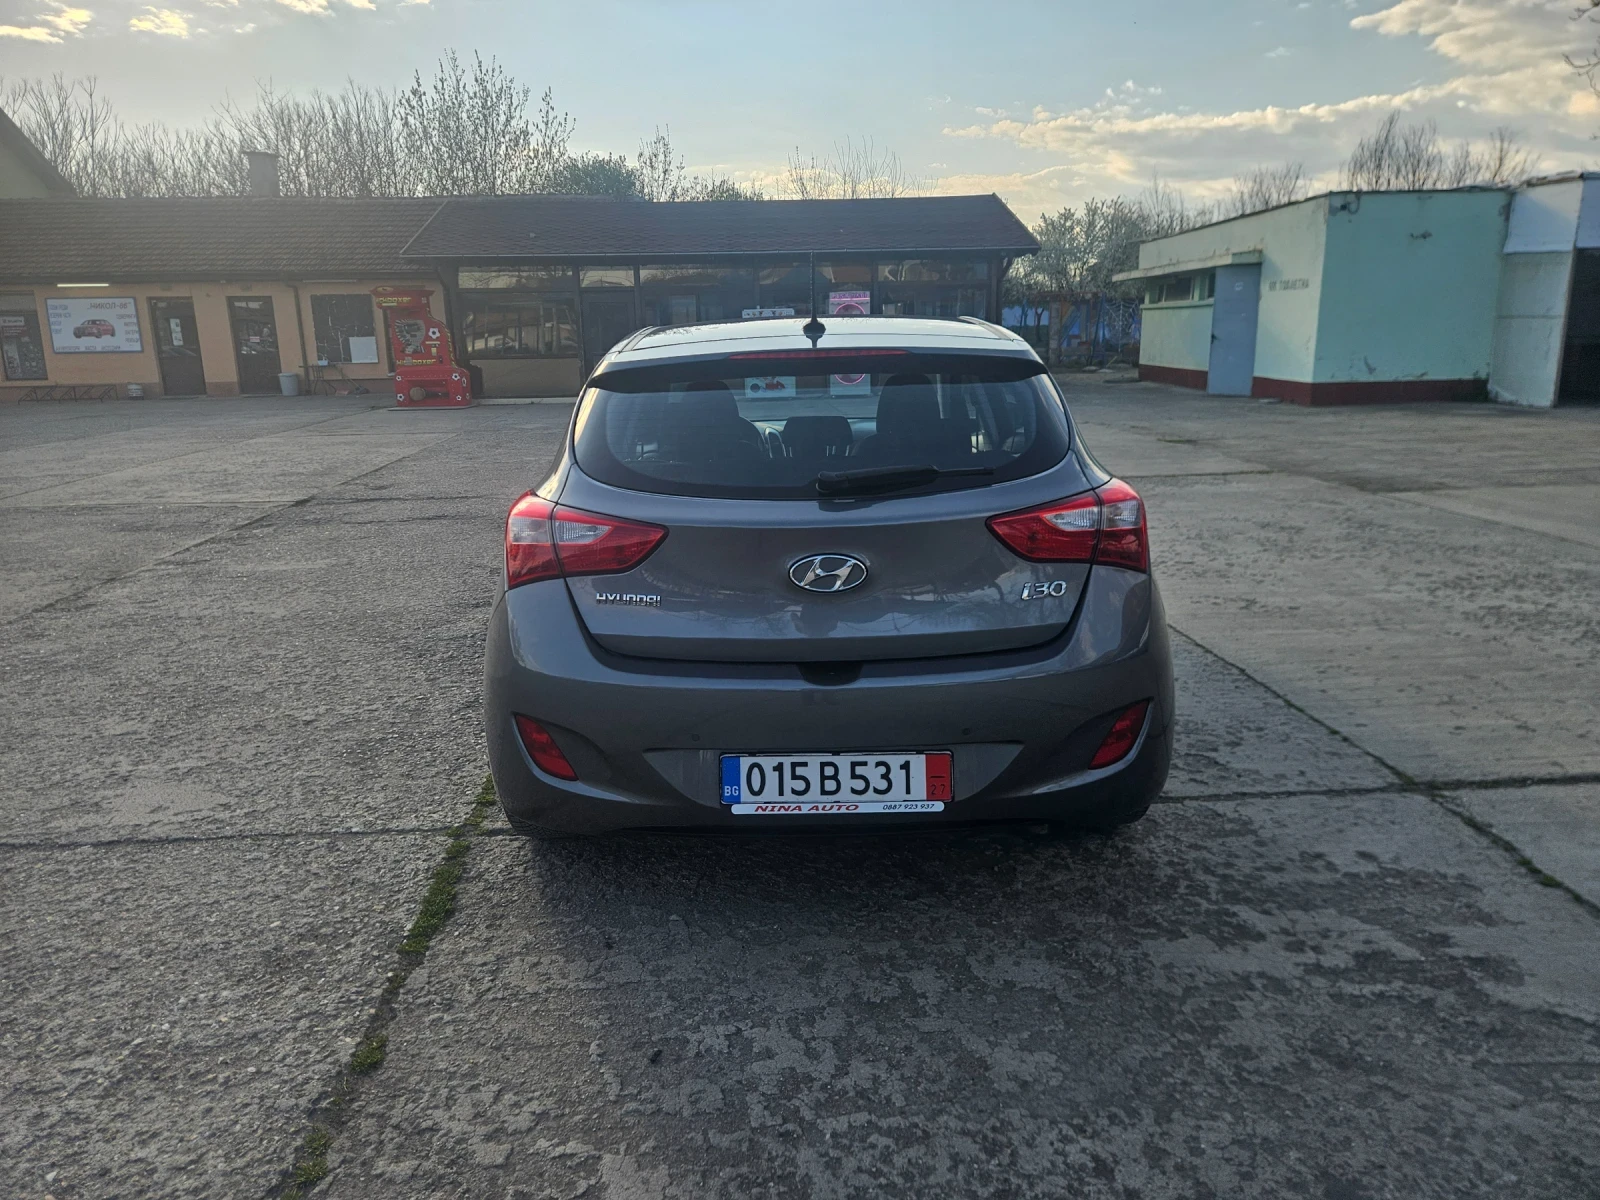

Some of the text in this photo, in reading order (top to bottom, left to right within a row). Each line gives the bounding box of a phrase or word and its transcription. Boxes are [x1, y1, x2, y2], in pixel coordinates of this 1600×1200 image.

[1021, 580, 1067, 600] i30
[596, 593, 661, 607] HYUNDAI
[724, 785, 739, 797] BG
[930, 783, 946, 796] 27
[754, 804, 803, 813] NINA
[807, 803, 860, 812] AUTO
